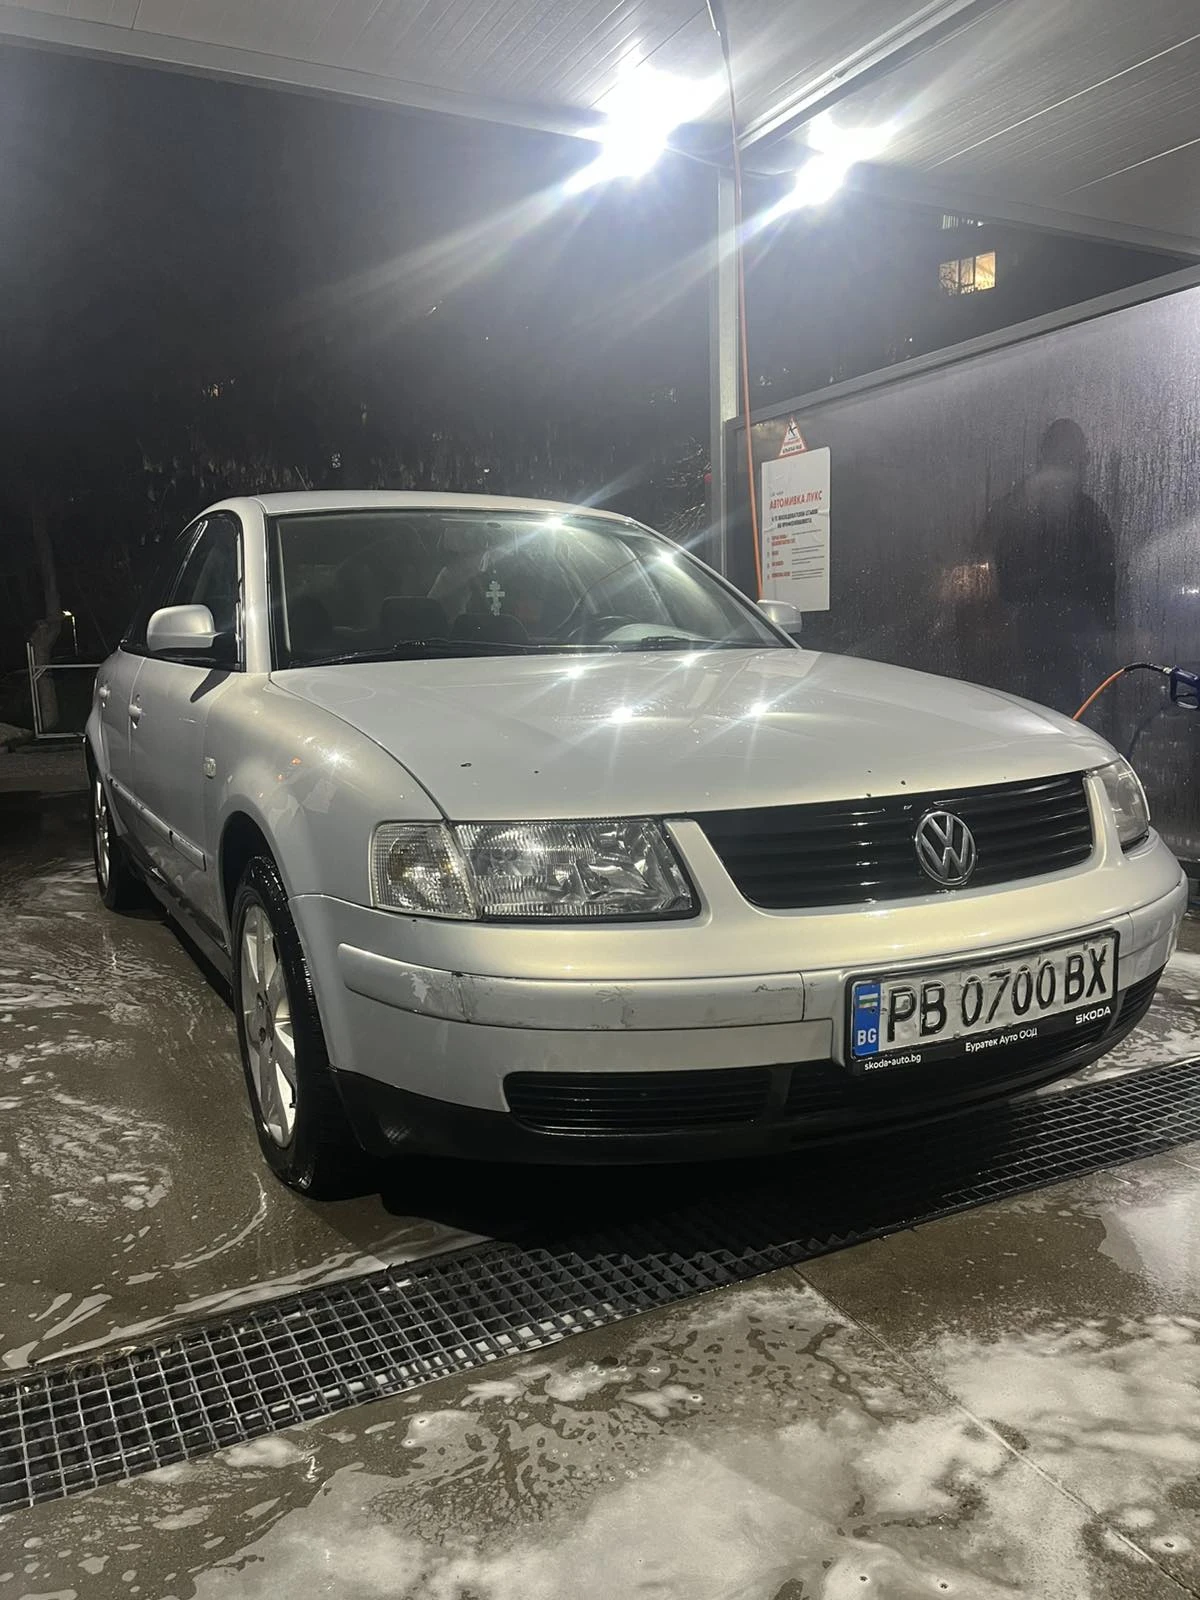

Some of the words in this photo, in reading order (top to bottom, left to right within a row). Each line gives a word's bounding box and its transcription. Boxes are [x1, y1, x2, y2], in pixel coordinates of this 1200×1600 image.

[769, 495, 805, 510] АВТОМИВКА
[806, 490, 822, 503] ЛУКС
[887, 980, 948, 1042] PB
[961, 959, 1056, 1028] 0700
[1064, 943, 1108, 1004] BX
[857, 1027, 877, 1046] BG
[965, 1037, 998, 1052] Еуратек
[999, 1033, 1019, 1047] Ауто
